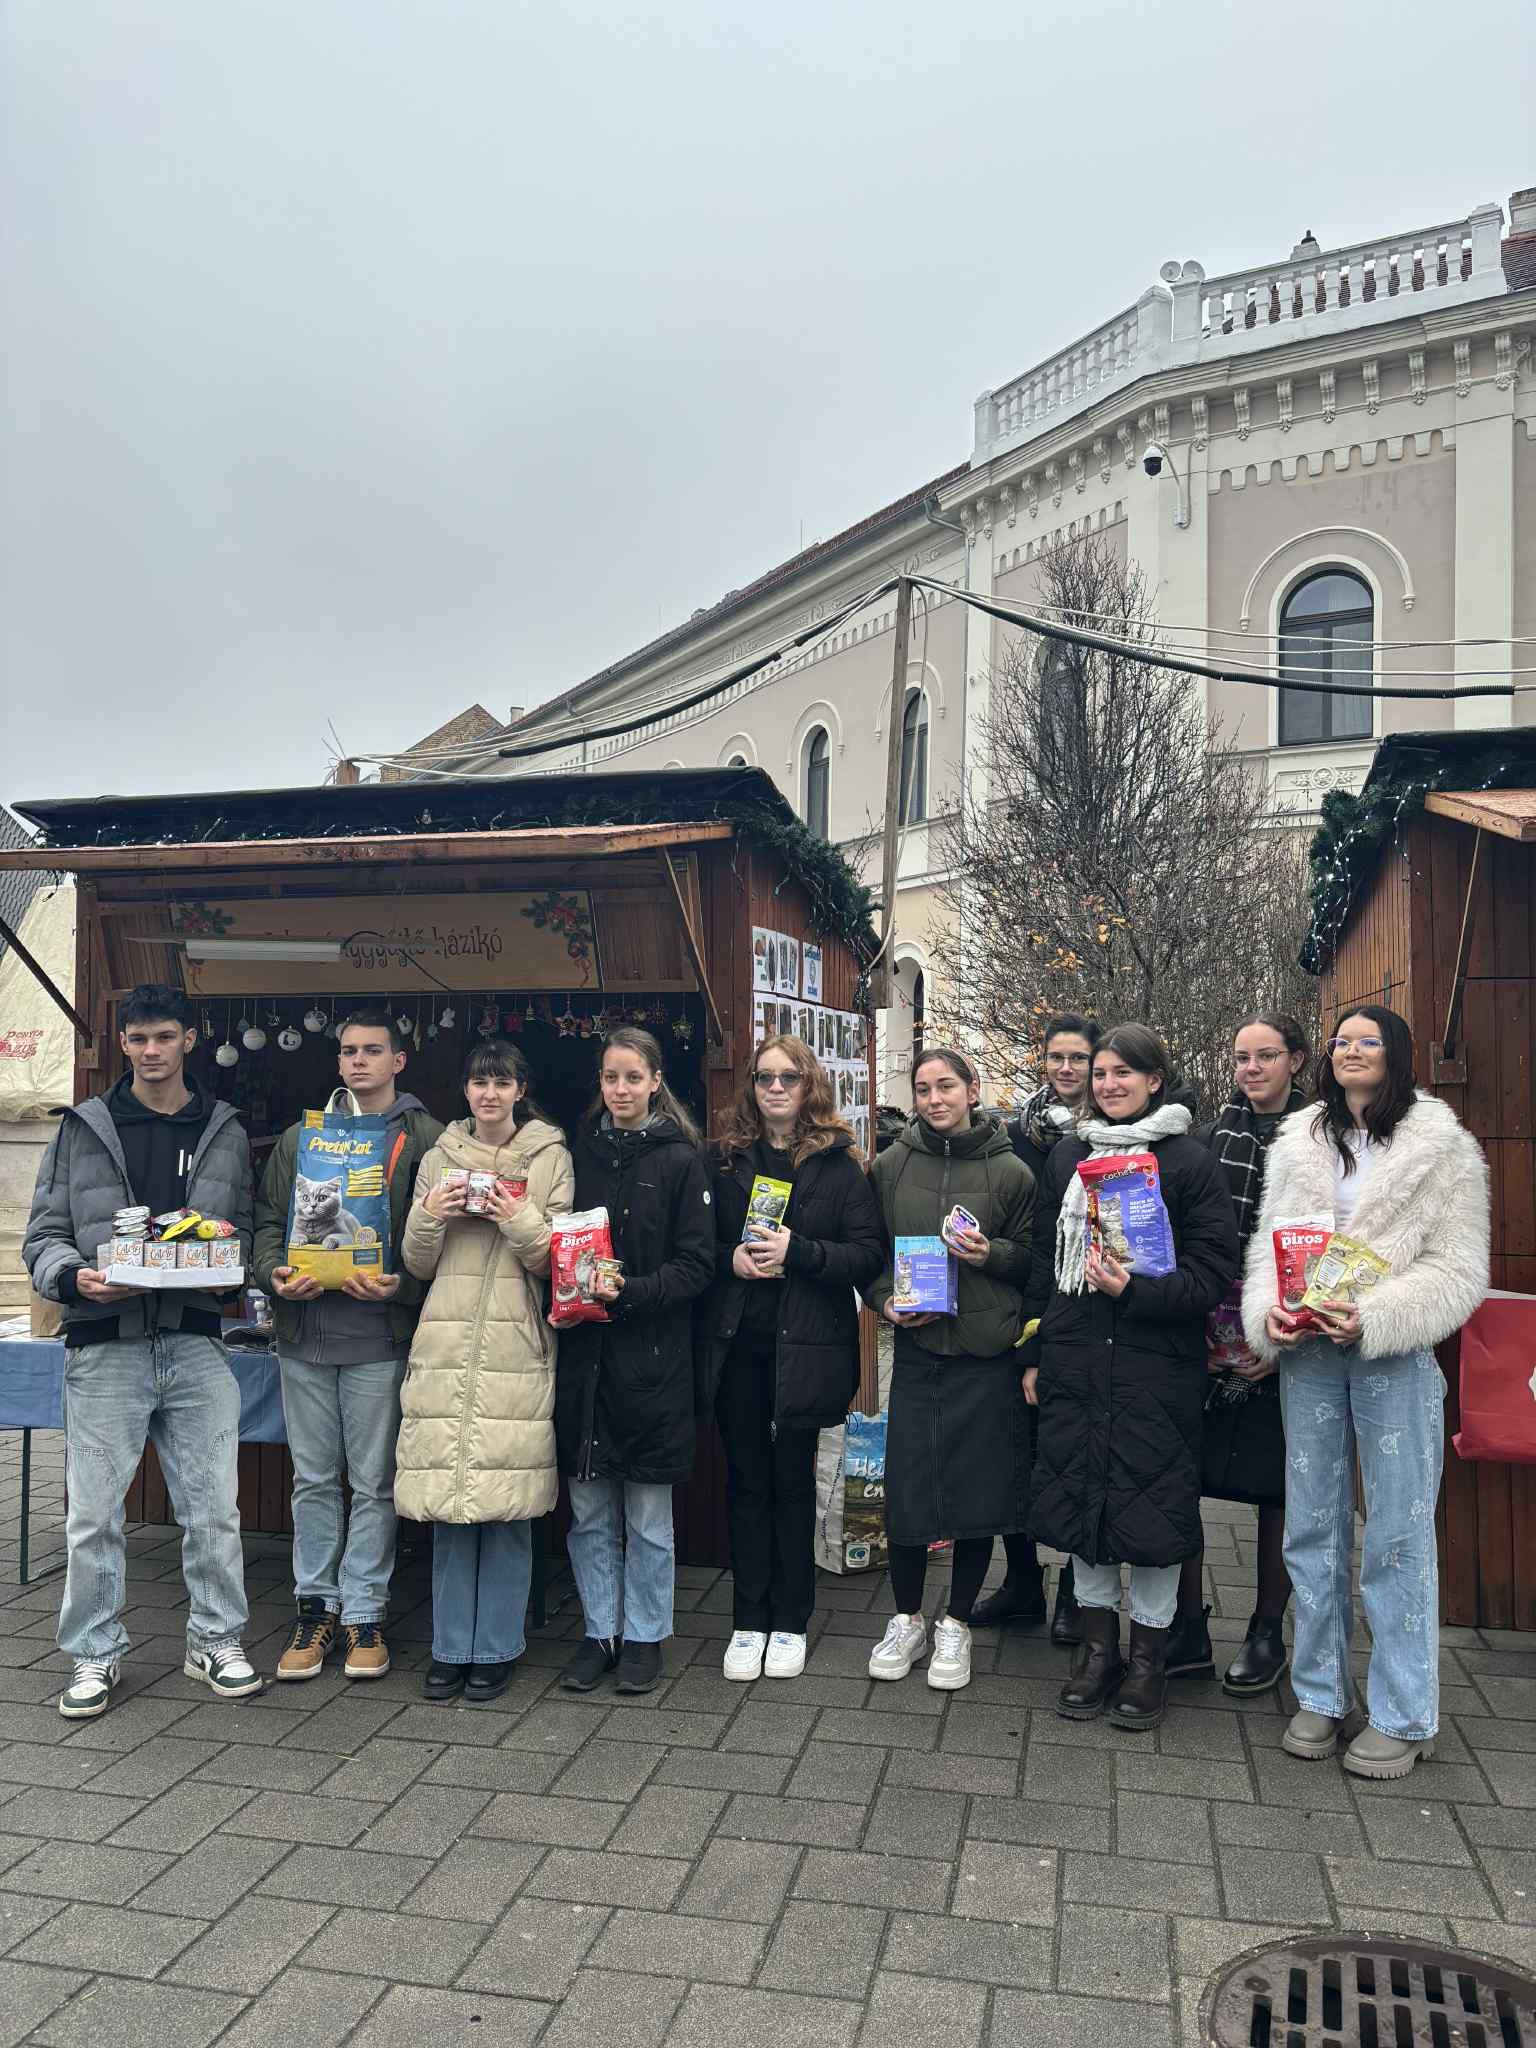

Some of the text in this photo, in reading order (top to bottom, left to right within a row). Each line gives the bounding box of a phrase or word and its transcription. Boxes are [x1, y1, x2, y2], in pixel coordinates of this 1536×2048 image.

[432, 925, 503, 961] házikó
[1281, 1231, 1323, 1250] piros
[855, 1456, 884, 1476] Hei
[864, 1483, 885, 1498] en
